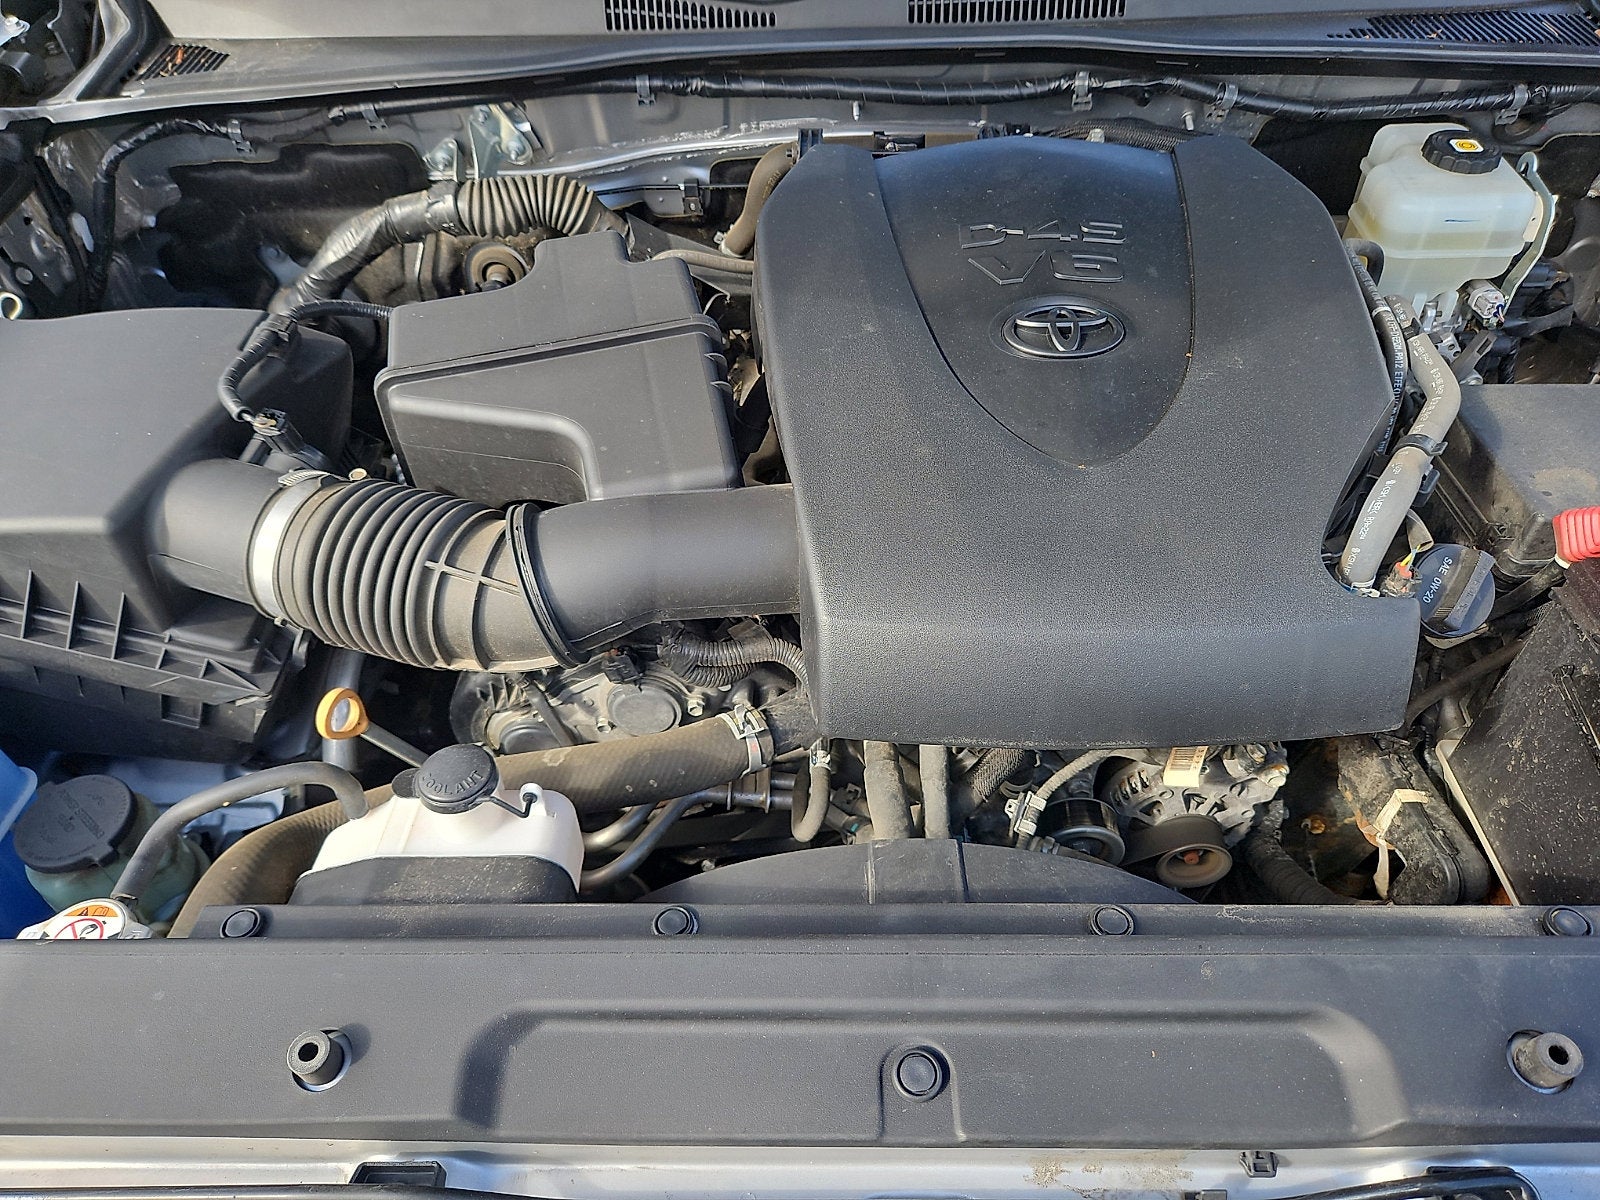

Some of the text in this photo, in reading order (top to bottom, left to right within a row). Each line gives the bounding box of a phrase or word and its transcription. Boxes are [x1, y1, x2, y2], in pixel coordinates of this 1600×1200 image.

[965, 249, 1126, 285] V6
[1421, 555, 1454, 605] SAE 0W-20
[421, 768, 485, 796] COOLANT
